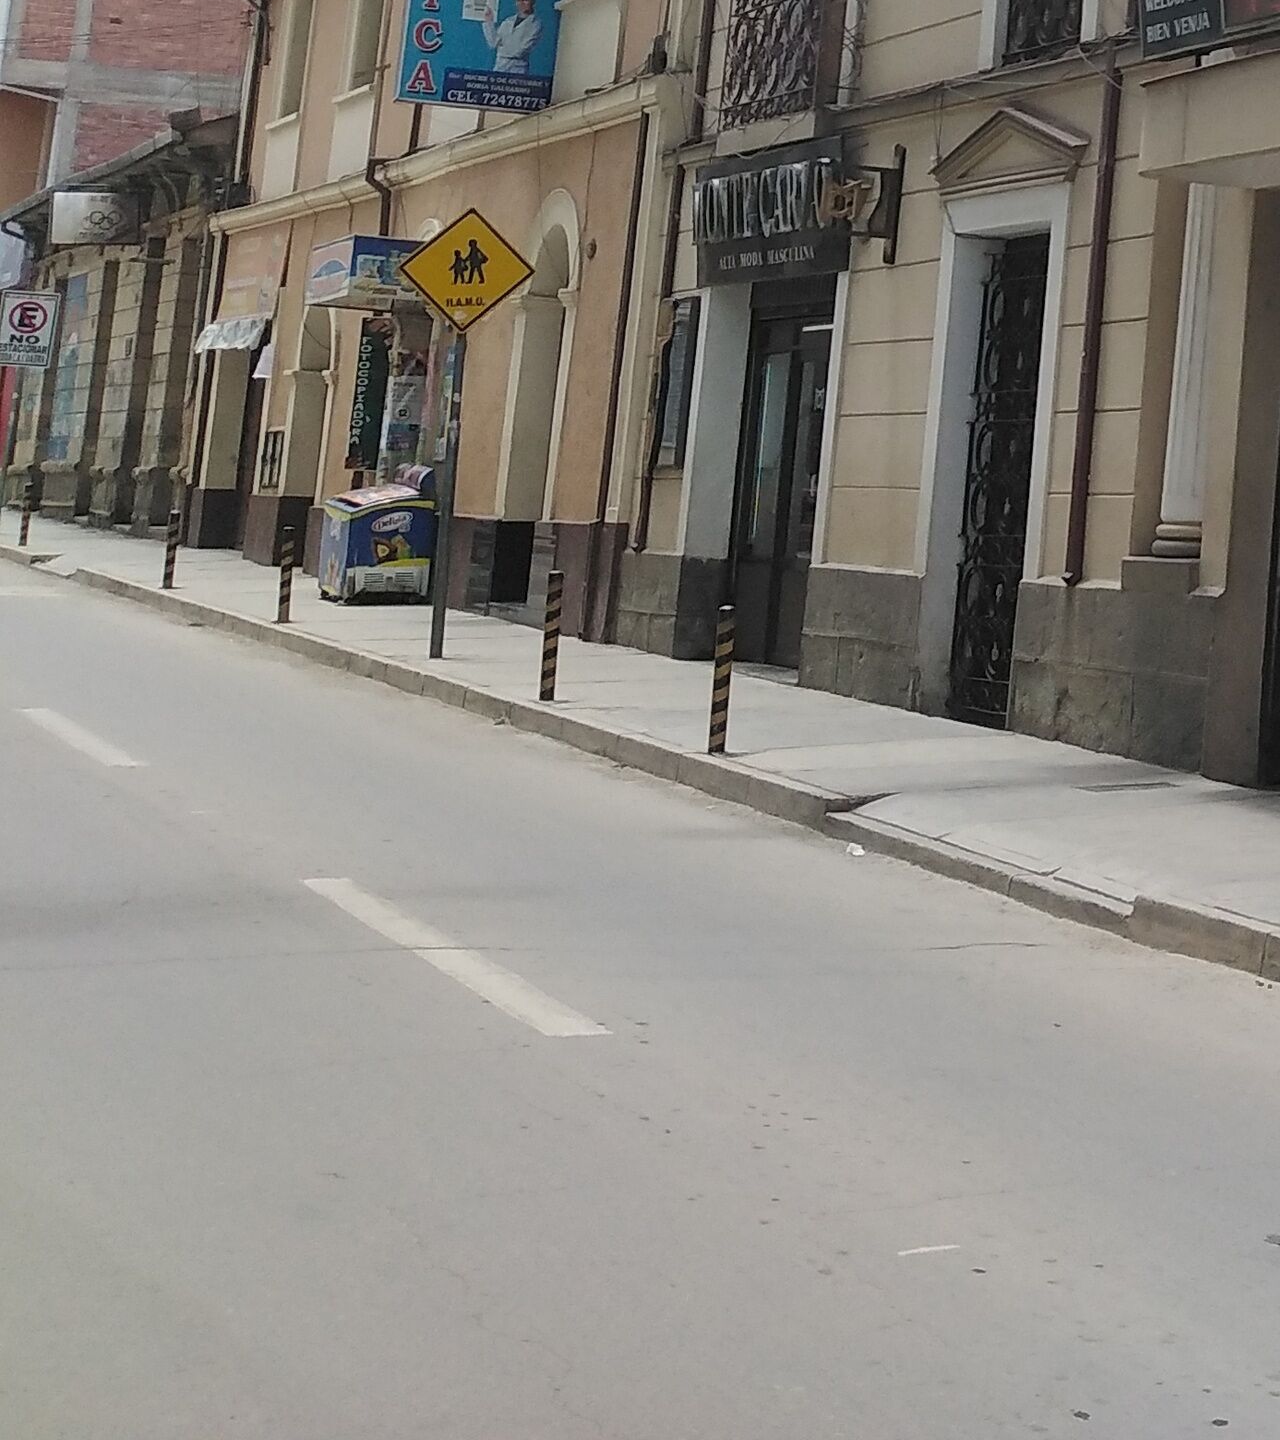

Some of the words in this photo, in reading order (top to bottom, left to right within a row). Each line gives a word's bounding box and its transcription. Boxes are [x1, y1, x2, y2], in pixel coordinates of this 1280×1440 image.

[1145, 21, 1171, 43] BIEN
[482, 92, 548, 109] 72478775
[719, 253, 737, 271] ALTA
[740, 250, 764, 268] MODA
[767, 245, 816, 265] MASCULINA
[10, 334, 41, 345] NO
[350, 336, 373, 445] FOTOCOPIADORA
